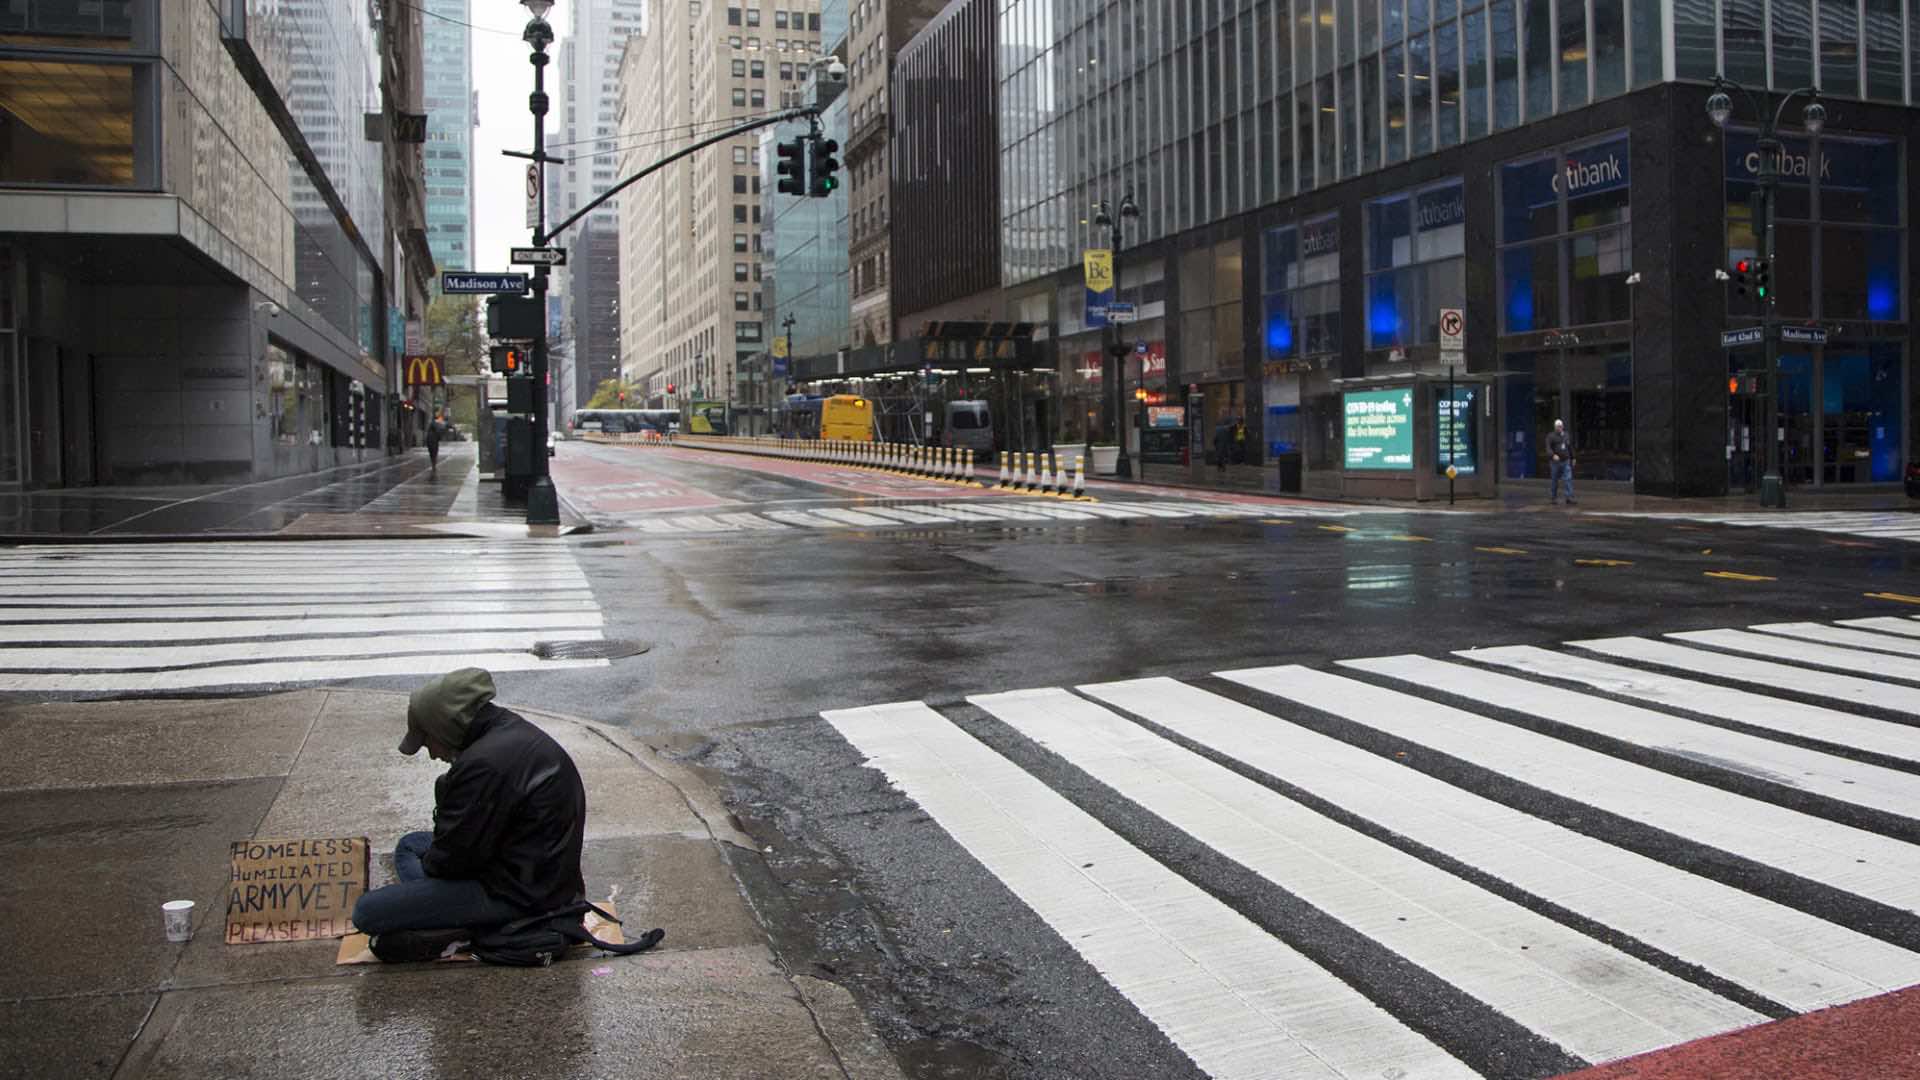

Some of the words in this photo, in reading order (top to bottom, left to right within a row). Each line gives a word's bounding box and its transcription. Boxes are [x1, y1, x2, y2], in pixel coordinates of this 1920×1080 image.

[1552, 153, 1622, 193] ctibank
[517, 252, 534, 260] ONE
[1089, 261, 1110, 279] Be
[446, 278, 497, 289] Madison
[500, 278, 523, 289] Ave
[1783, 328, 1811, 339] Madison
[231, 838, 353, 861] HOMELESS
[229, 920, 300, 942] PLEASE
